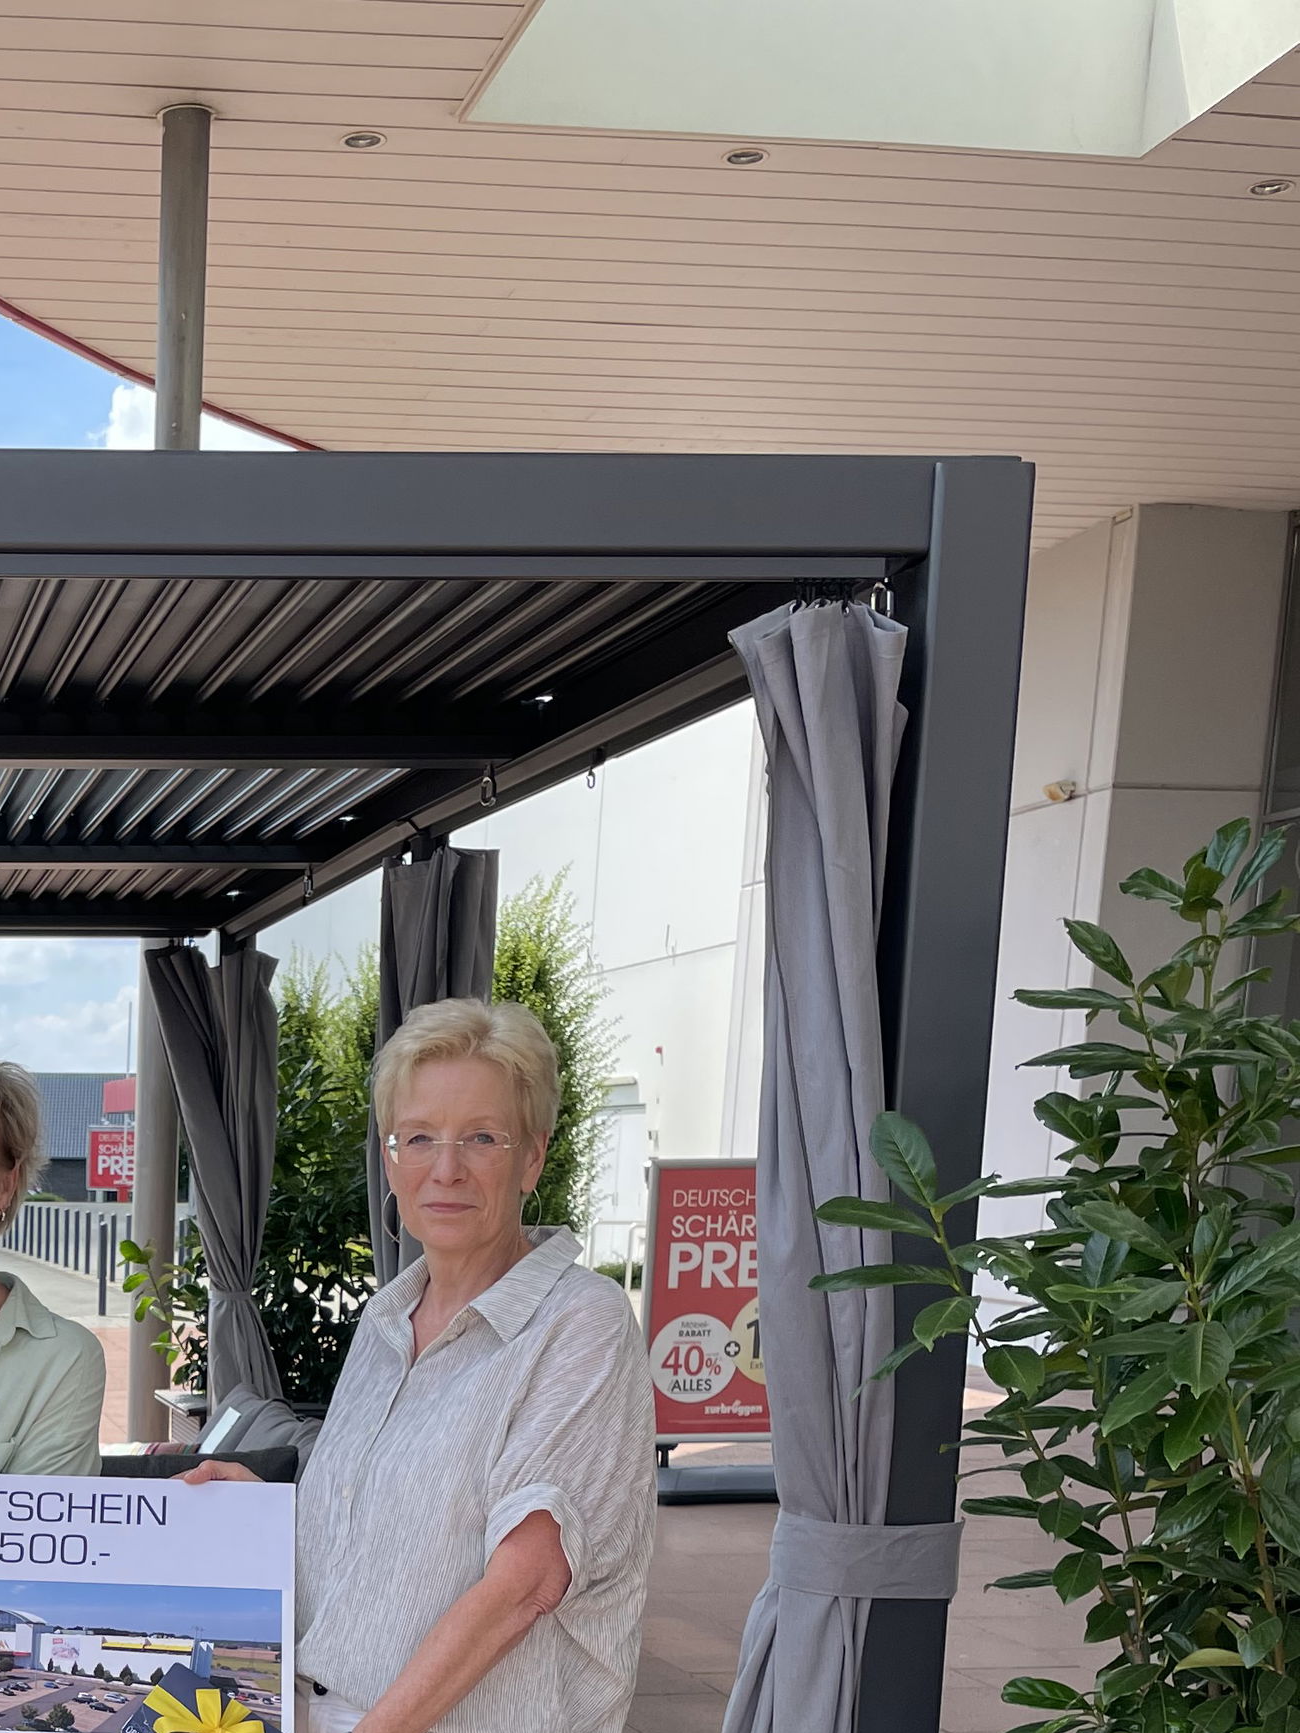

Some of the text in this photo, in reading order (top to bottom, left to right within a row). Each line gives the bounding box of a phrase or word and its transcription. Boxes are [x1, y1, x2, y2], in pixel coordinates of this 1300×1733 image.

[671, 1210, 756, 1238] SCHÄR
[668, 1241, 758, 1289] PRE
[661, 1345, 721, 1377] 40%
[671, 1379, 712, 1392] ALLES
